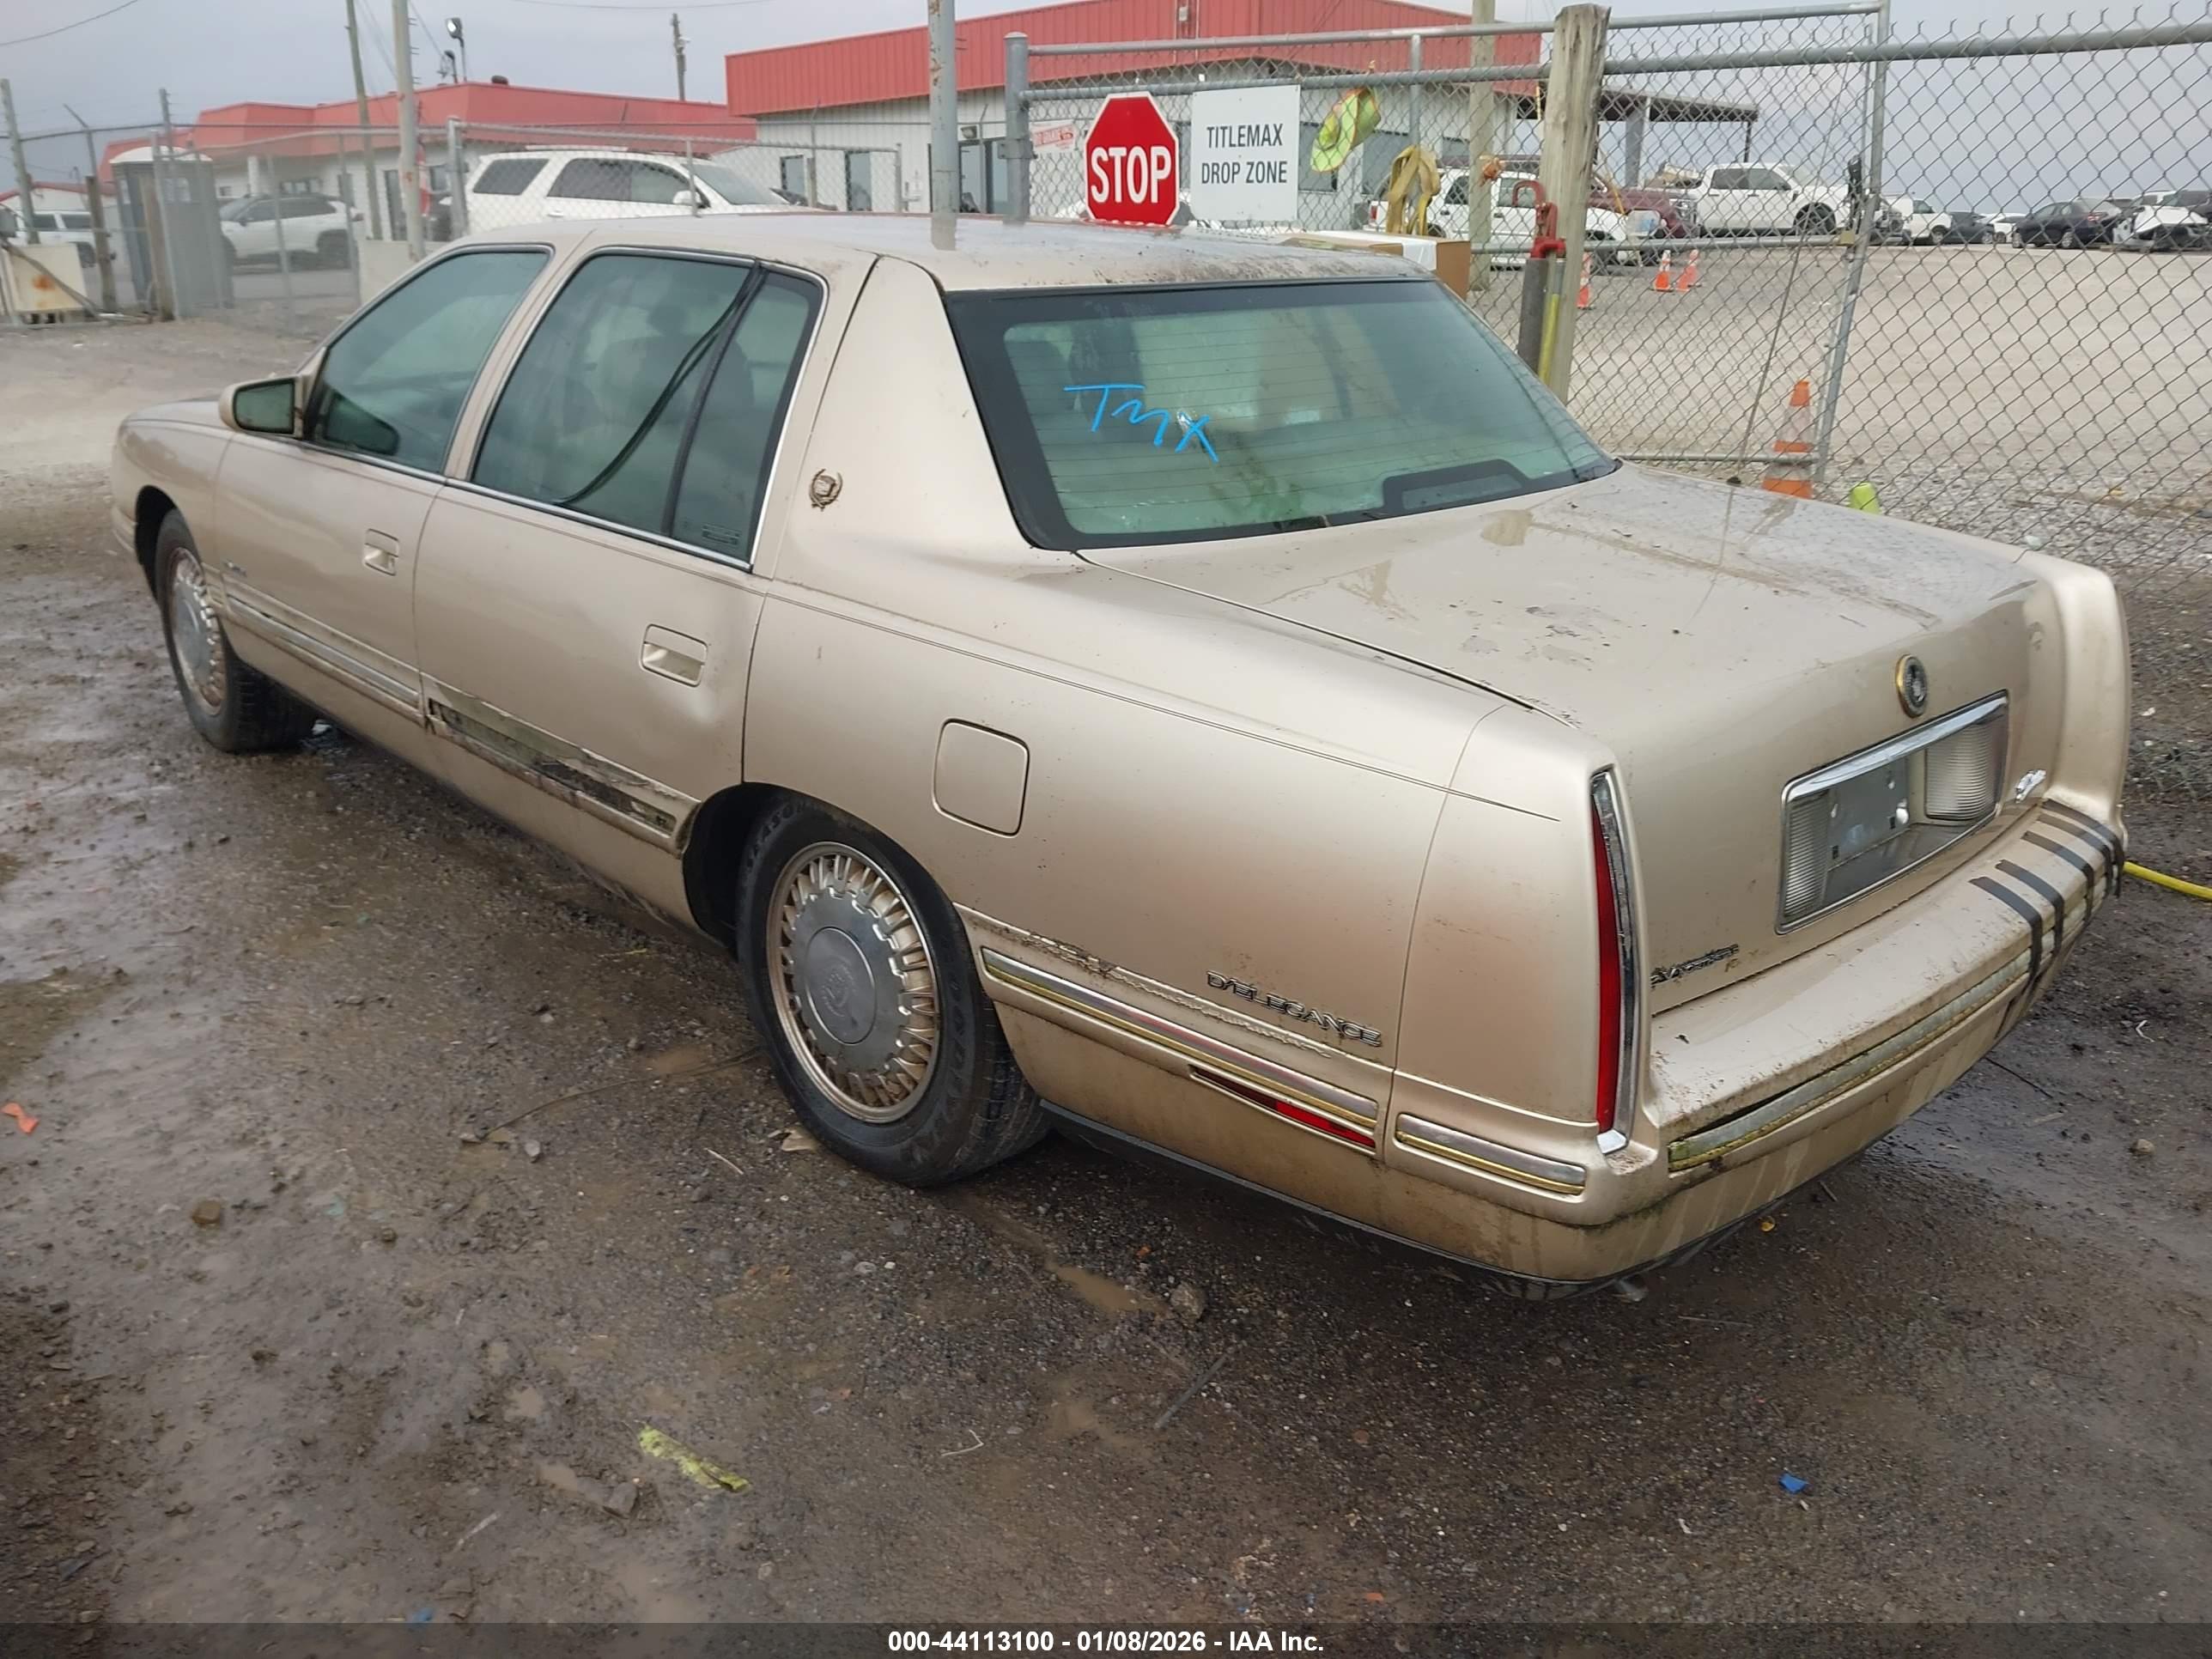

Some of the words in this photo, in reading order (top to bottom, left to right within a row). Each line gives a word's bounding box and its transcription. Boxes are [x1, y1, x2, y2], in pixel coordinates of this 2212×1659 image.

[1206, 124, 1284, 149] TITLEMAX
[1091, 145, 1172, 204] STOP
[1201, 161, 1242, 185] DROP
[1245, 161, 1288, 184] ZONE
